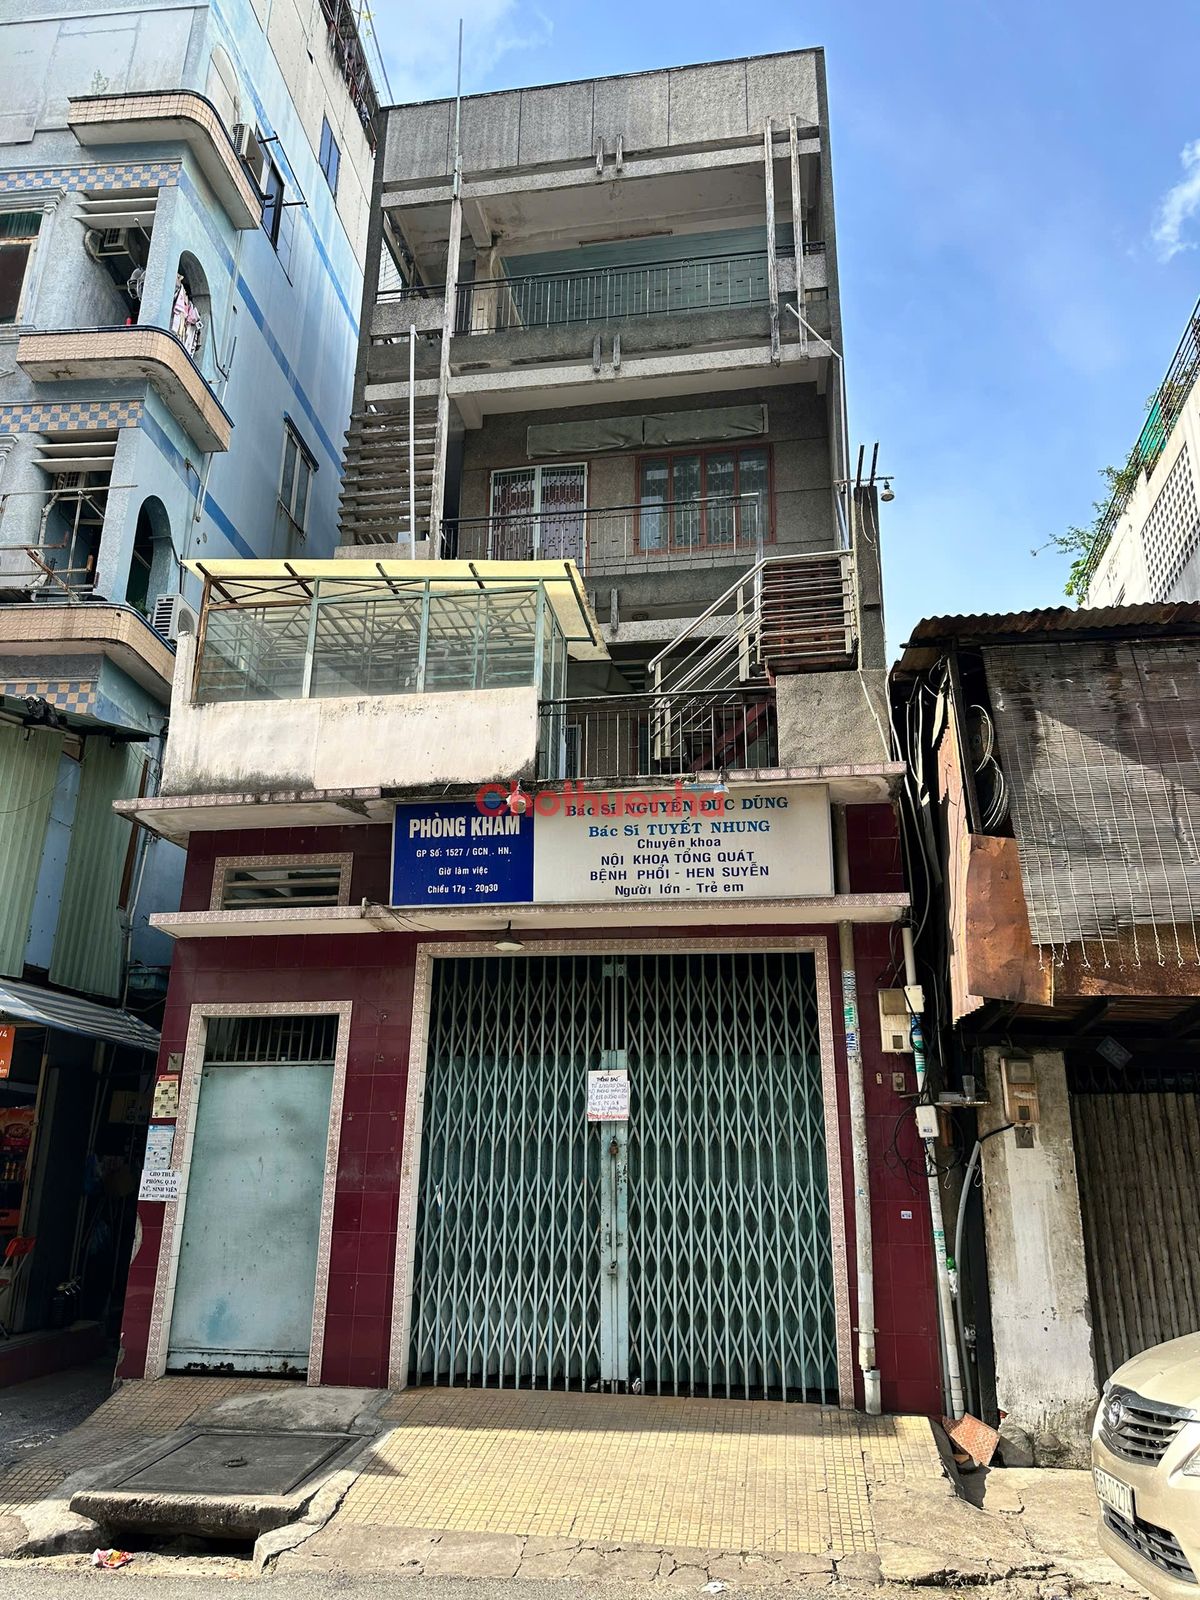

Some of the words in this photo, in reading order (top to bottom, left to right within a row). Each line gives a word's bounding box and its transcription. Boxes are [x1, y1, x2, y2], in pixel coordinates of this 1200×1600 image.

[565, 804, 595, 817] Bác
[625, 796, 694, 815] NGUYỄN
[742, 794, 789, 810] DŨNG
[409, 812, 466, 839] PHÒNG
[471, 811, 520, 837] KHÁM
[588, 824, 618, 838] Bác
[647, 816, 703, 836] TUYẾT
[711, 820, 771, 834] NHUNG
[416, 849, 427, 857] GP
[429, 847, 443, 857] Số:
[445, 848, 464, 857] 1527
[498, 847, 512, 855] HN.
[637, 838, 685, 851] Chuyên
[690, 837, 721, 847] khoa
[601, 852, 625, 868] NỘI
[633, 854, 670, 865] KHOA
[675, 848, 711, 864] TỔNG
[717, 849, 754, 863] QUÁT
[438, 866, 452, 876] Giờ
[454, 866, 469, 875] làm
[472, 866, 489, 875] việc
[590, 868, 627, 884] BỆNH
[637, 864, 669, 880] PHỔI
[686, 867, 715, 878] HEN
[722, 862, 770, 877] SUYỄN
[452, 884, 466, 894] 17g
[475, 883, 499, 894] 20g30
[615, 884, 652, 898] Người
[659, 883, 680, 894] lớn
[696, 881, 718, 893] Trẻ
[723, 882, 744, 892] em
